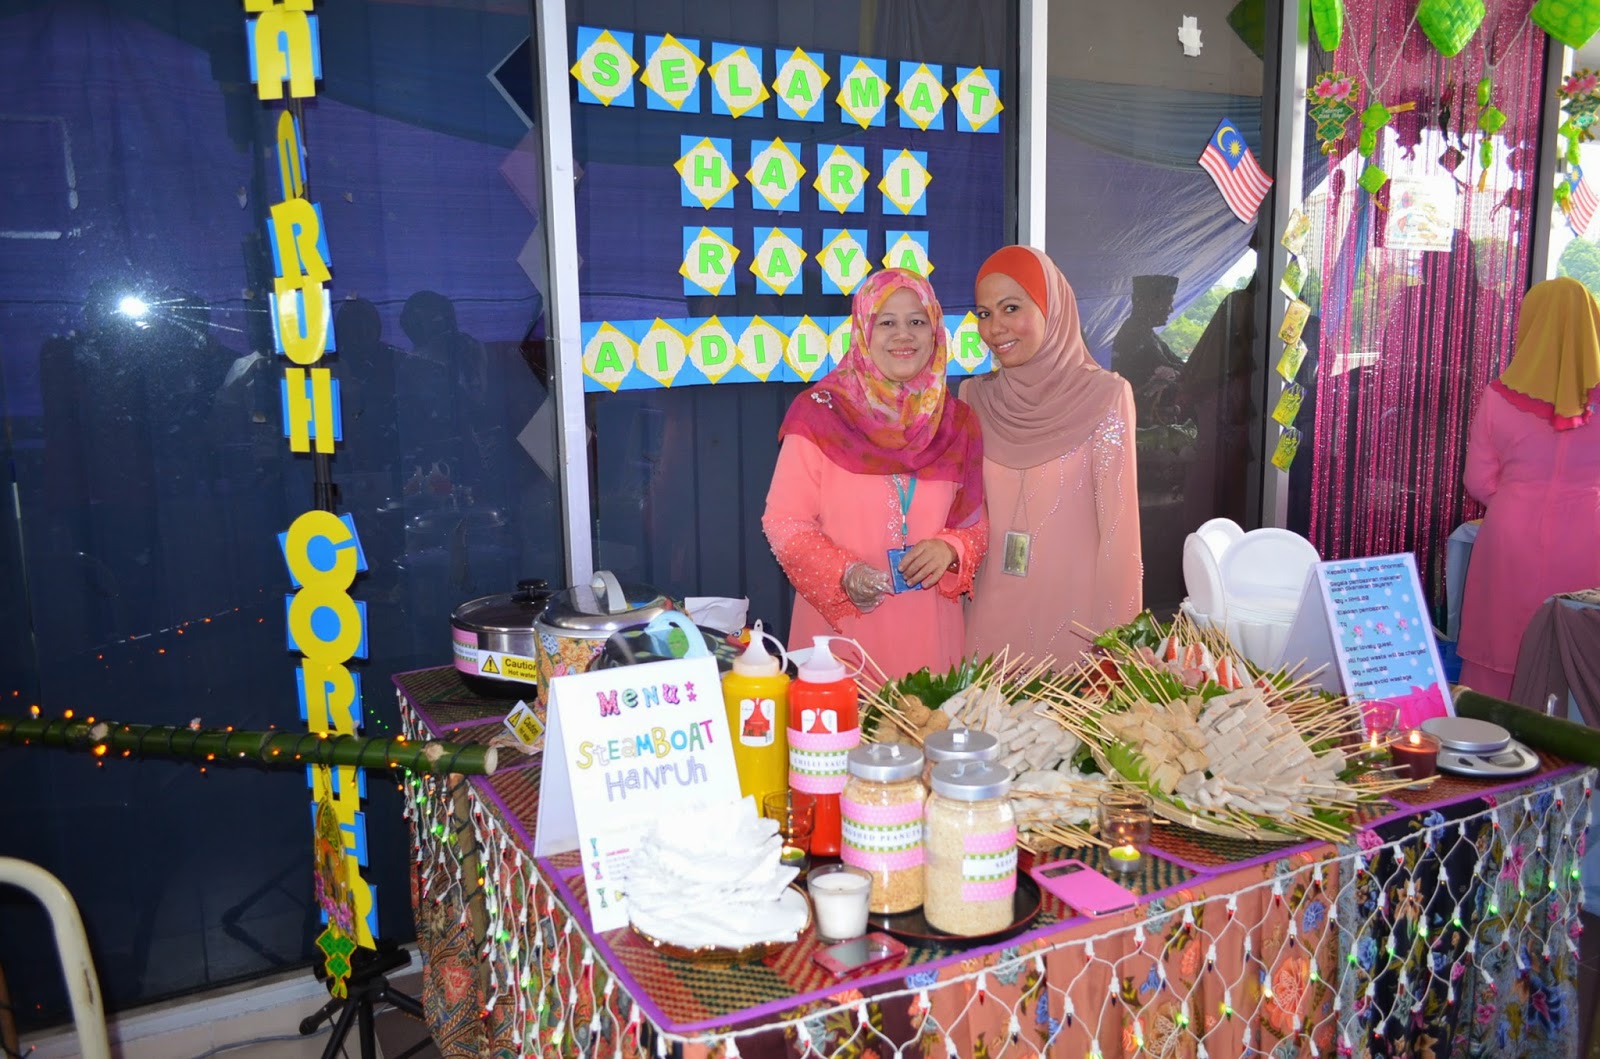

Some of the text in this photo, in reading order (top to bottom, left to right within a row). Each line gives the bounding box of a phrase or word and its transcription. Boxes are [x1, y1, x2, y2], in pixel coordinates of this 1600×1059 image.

[592, 52, 990, 115] SELAMAT
[694, 155, 911, 198] HARI
[699, 243, 921, 278] RAYA
[505, 657, 537, 671] Caution
[825, 760, 848, 768] SAUC
